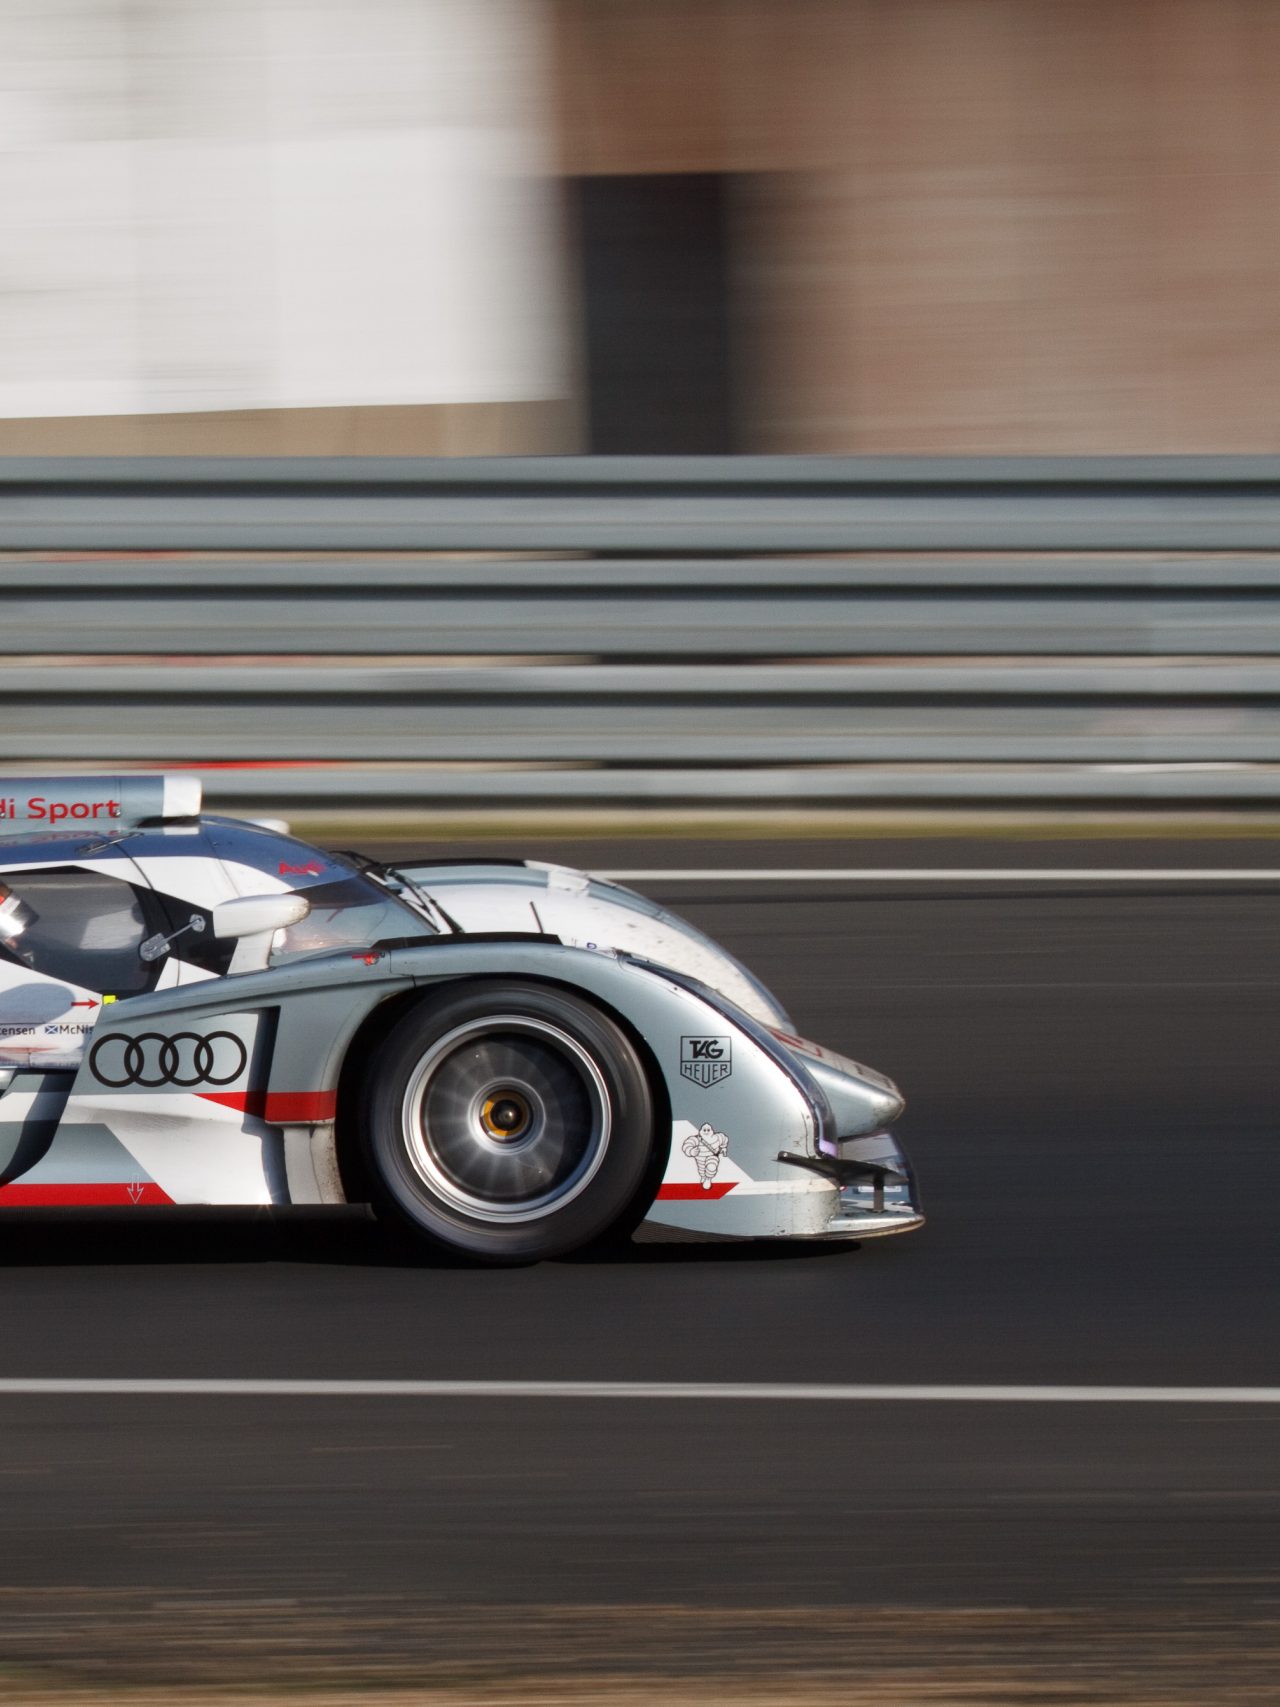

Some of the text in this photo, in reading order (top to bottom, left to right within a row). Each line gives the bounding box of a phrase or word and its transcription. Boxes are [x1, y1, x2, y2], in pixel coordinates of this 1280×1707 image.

[27, 797, 120, 824] Sport
[689, 1040, 724, 1059] TAG
[684, 1063, 728, 1085] HEUER
